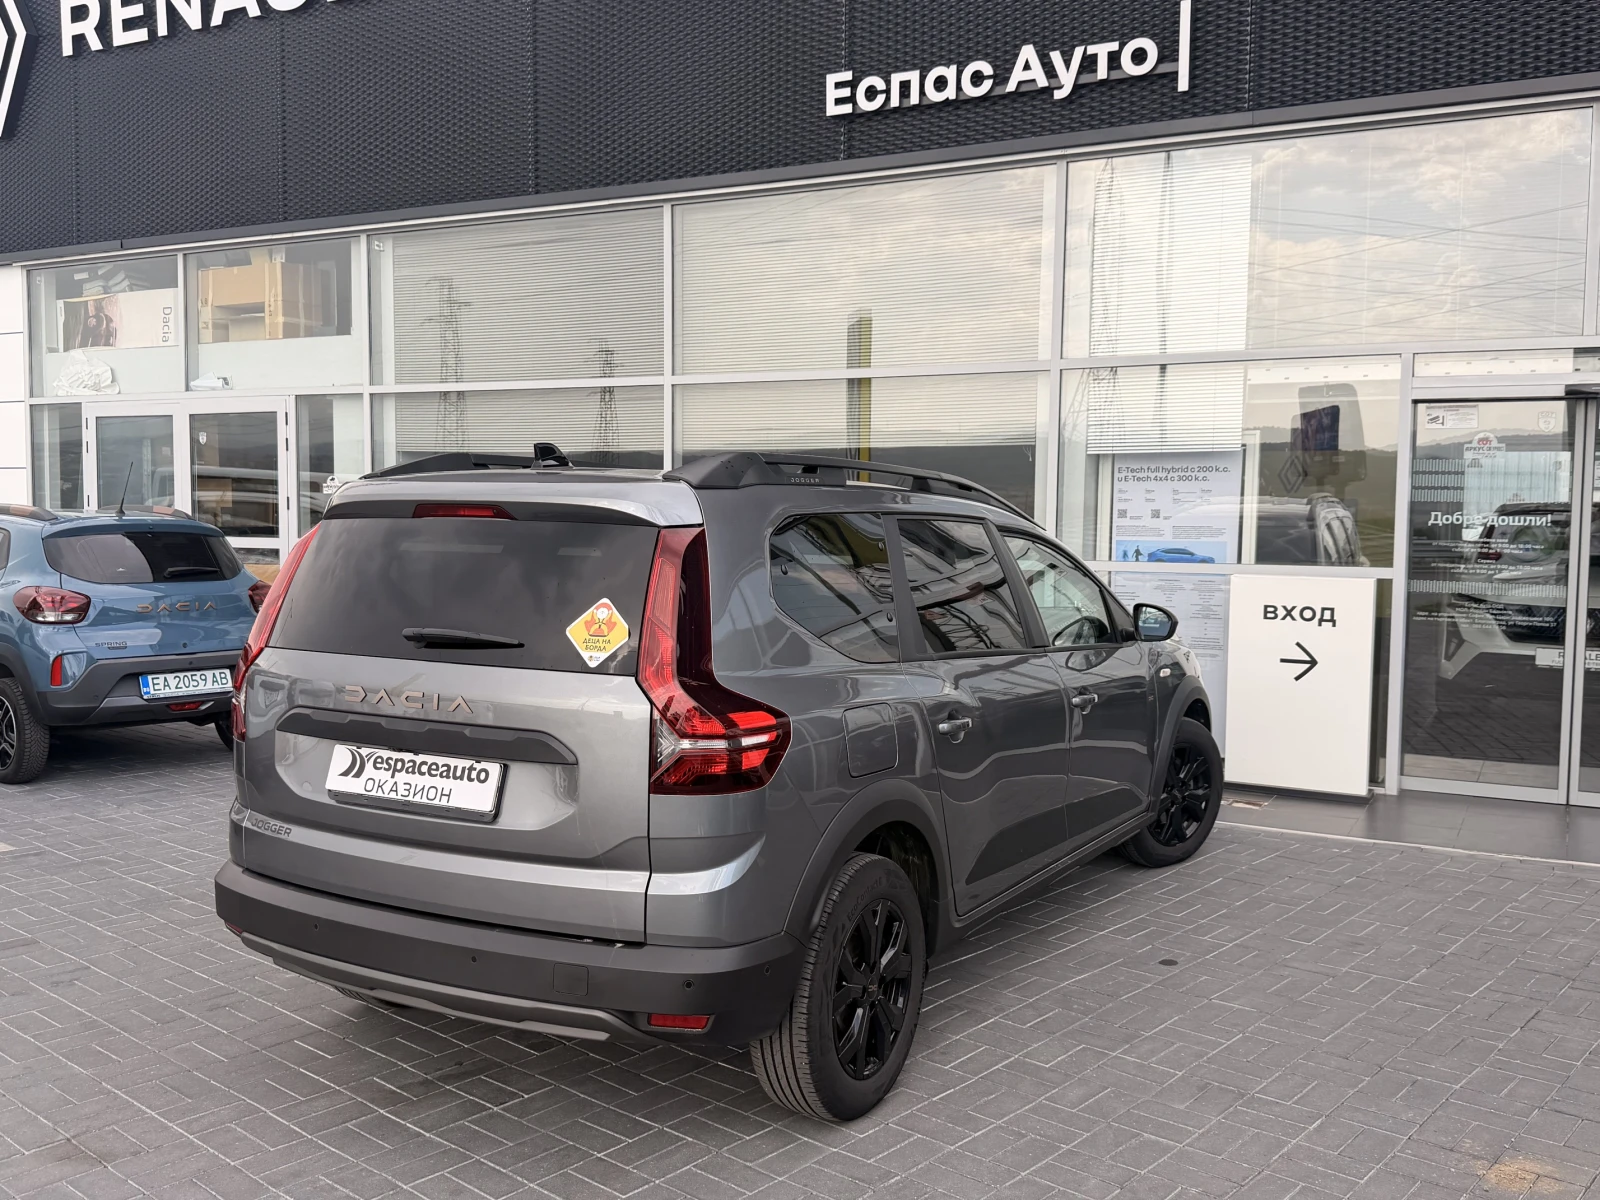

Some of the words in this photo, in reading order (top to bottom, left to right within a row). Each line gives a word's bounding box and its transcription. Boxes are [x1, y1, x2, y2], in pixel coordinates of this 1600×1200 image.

[826, 60, 994, 117] Еспас
[1005, 37, 1158, 100] Ауто
[161, 306, 173, 343] Dacia
[1117, 465, 1146, 473] E-Tech
[1147, 465, 1160, 473] full
[1161, 465, 1189, 475] hybrid
[1196, 465, 1214, 473] 200
[1124, 474, 1152, 483] E-Tech
[1177, 474, 1193, 482] 300
[1427, 511, 1483, 528] Добре
[1486, 513, 1552, 527] дошли!
[136, 601, 217, 614] DACIA
[582, 637, 601, 645] ДЕЦА
[584, 644, 607, 652] БОРДА
[151, 676, 171, 692] EA
[173, 673, 207, 690] 2059
[211, 671, 229, 687] AB
[344, 685, 474, 715] DACIA
[371, 752, 490, 785] espaceauto
[363, 777, 453, 804] ОКАЗИОН
[250, 817, 293, 838] JOGGER
